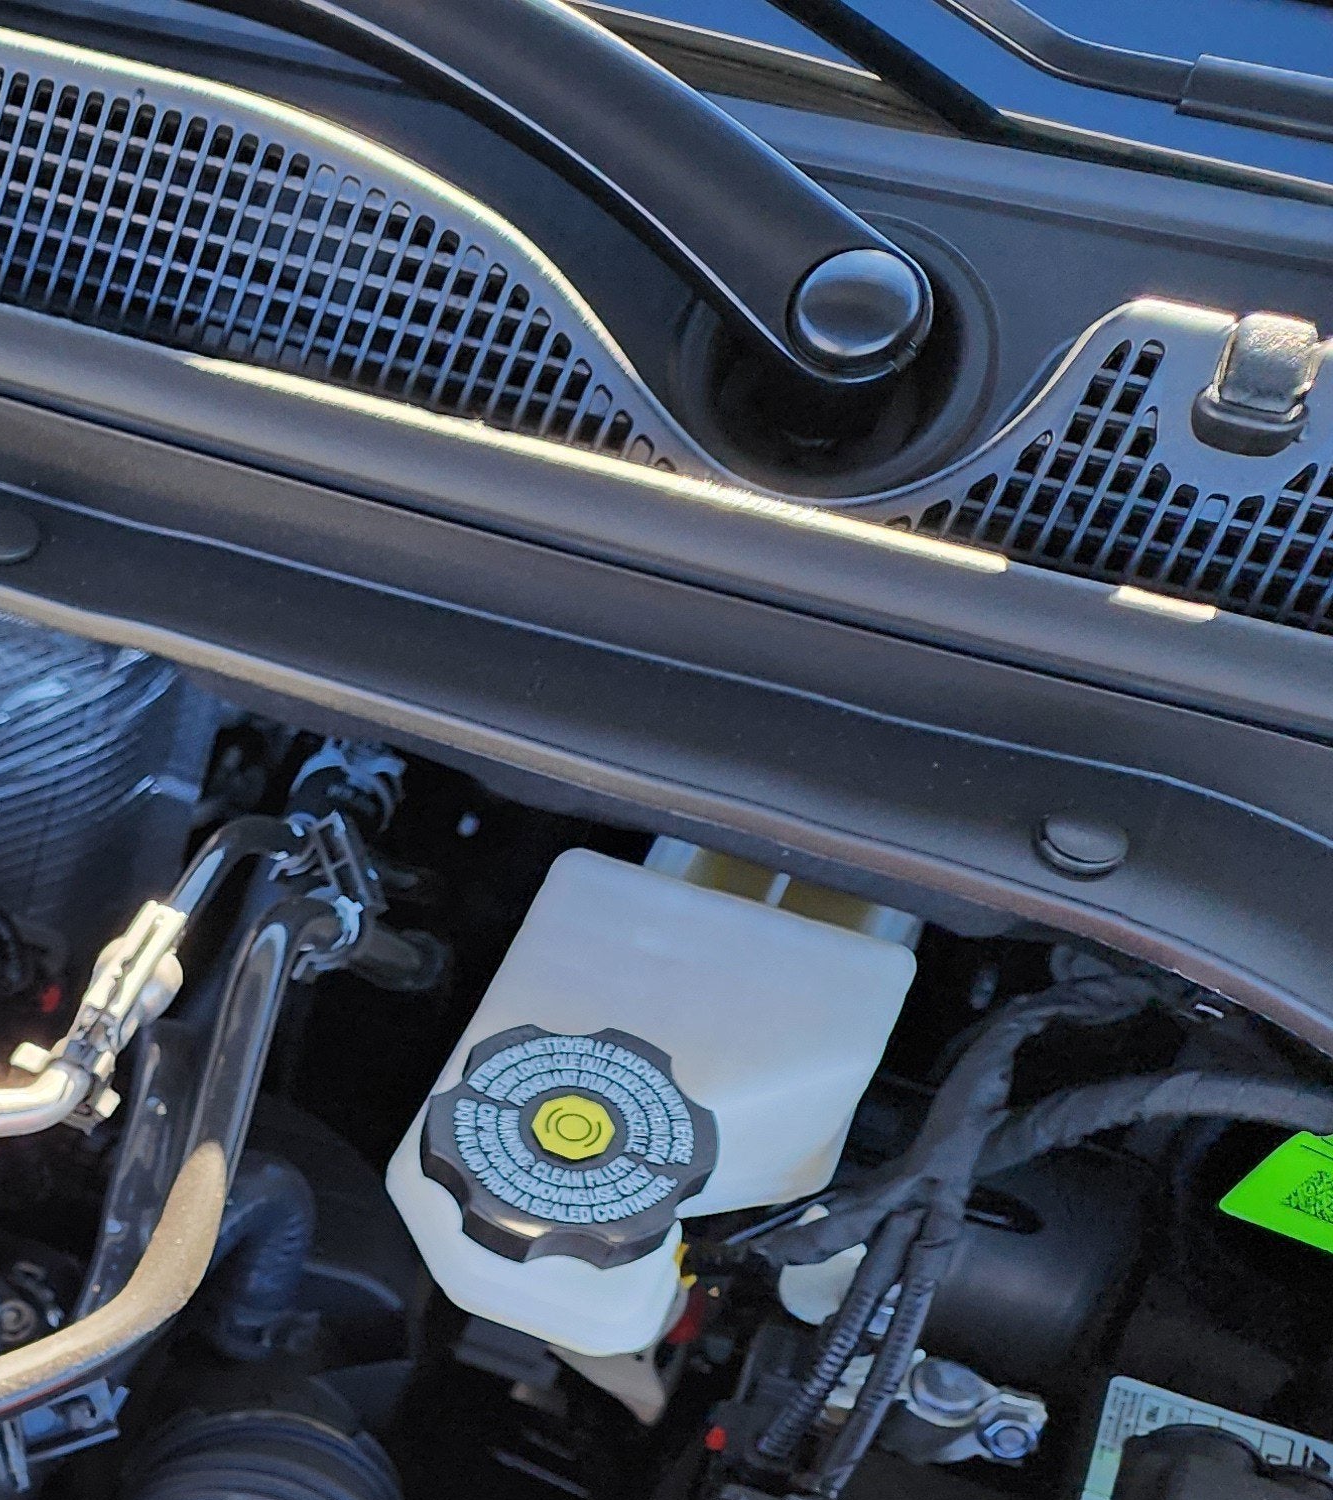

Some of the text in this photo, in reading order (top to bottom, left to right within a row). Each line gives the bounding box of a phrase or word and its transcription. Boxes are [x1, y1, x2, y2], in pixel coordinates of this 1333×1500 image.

[592, 1039, 616, 1060] LE
[475, 1100, 502, 1131] CAP
[476, 1130, 521, 1180] BEFORE
[526, 1159, 585, 1188] CLEAN
[582, 1152, 638, 1188] FILLER
[455, 1135, 491, 1173] FLUID
[473, 1166, 524, 1206] FROM
[512, 1191, 534, 1212] A
[525, 1197, 593, 1224] SEALED
[612, 1162, 659, 1198] ONLY
